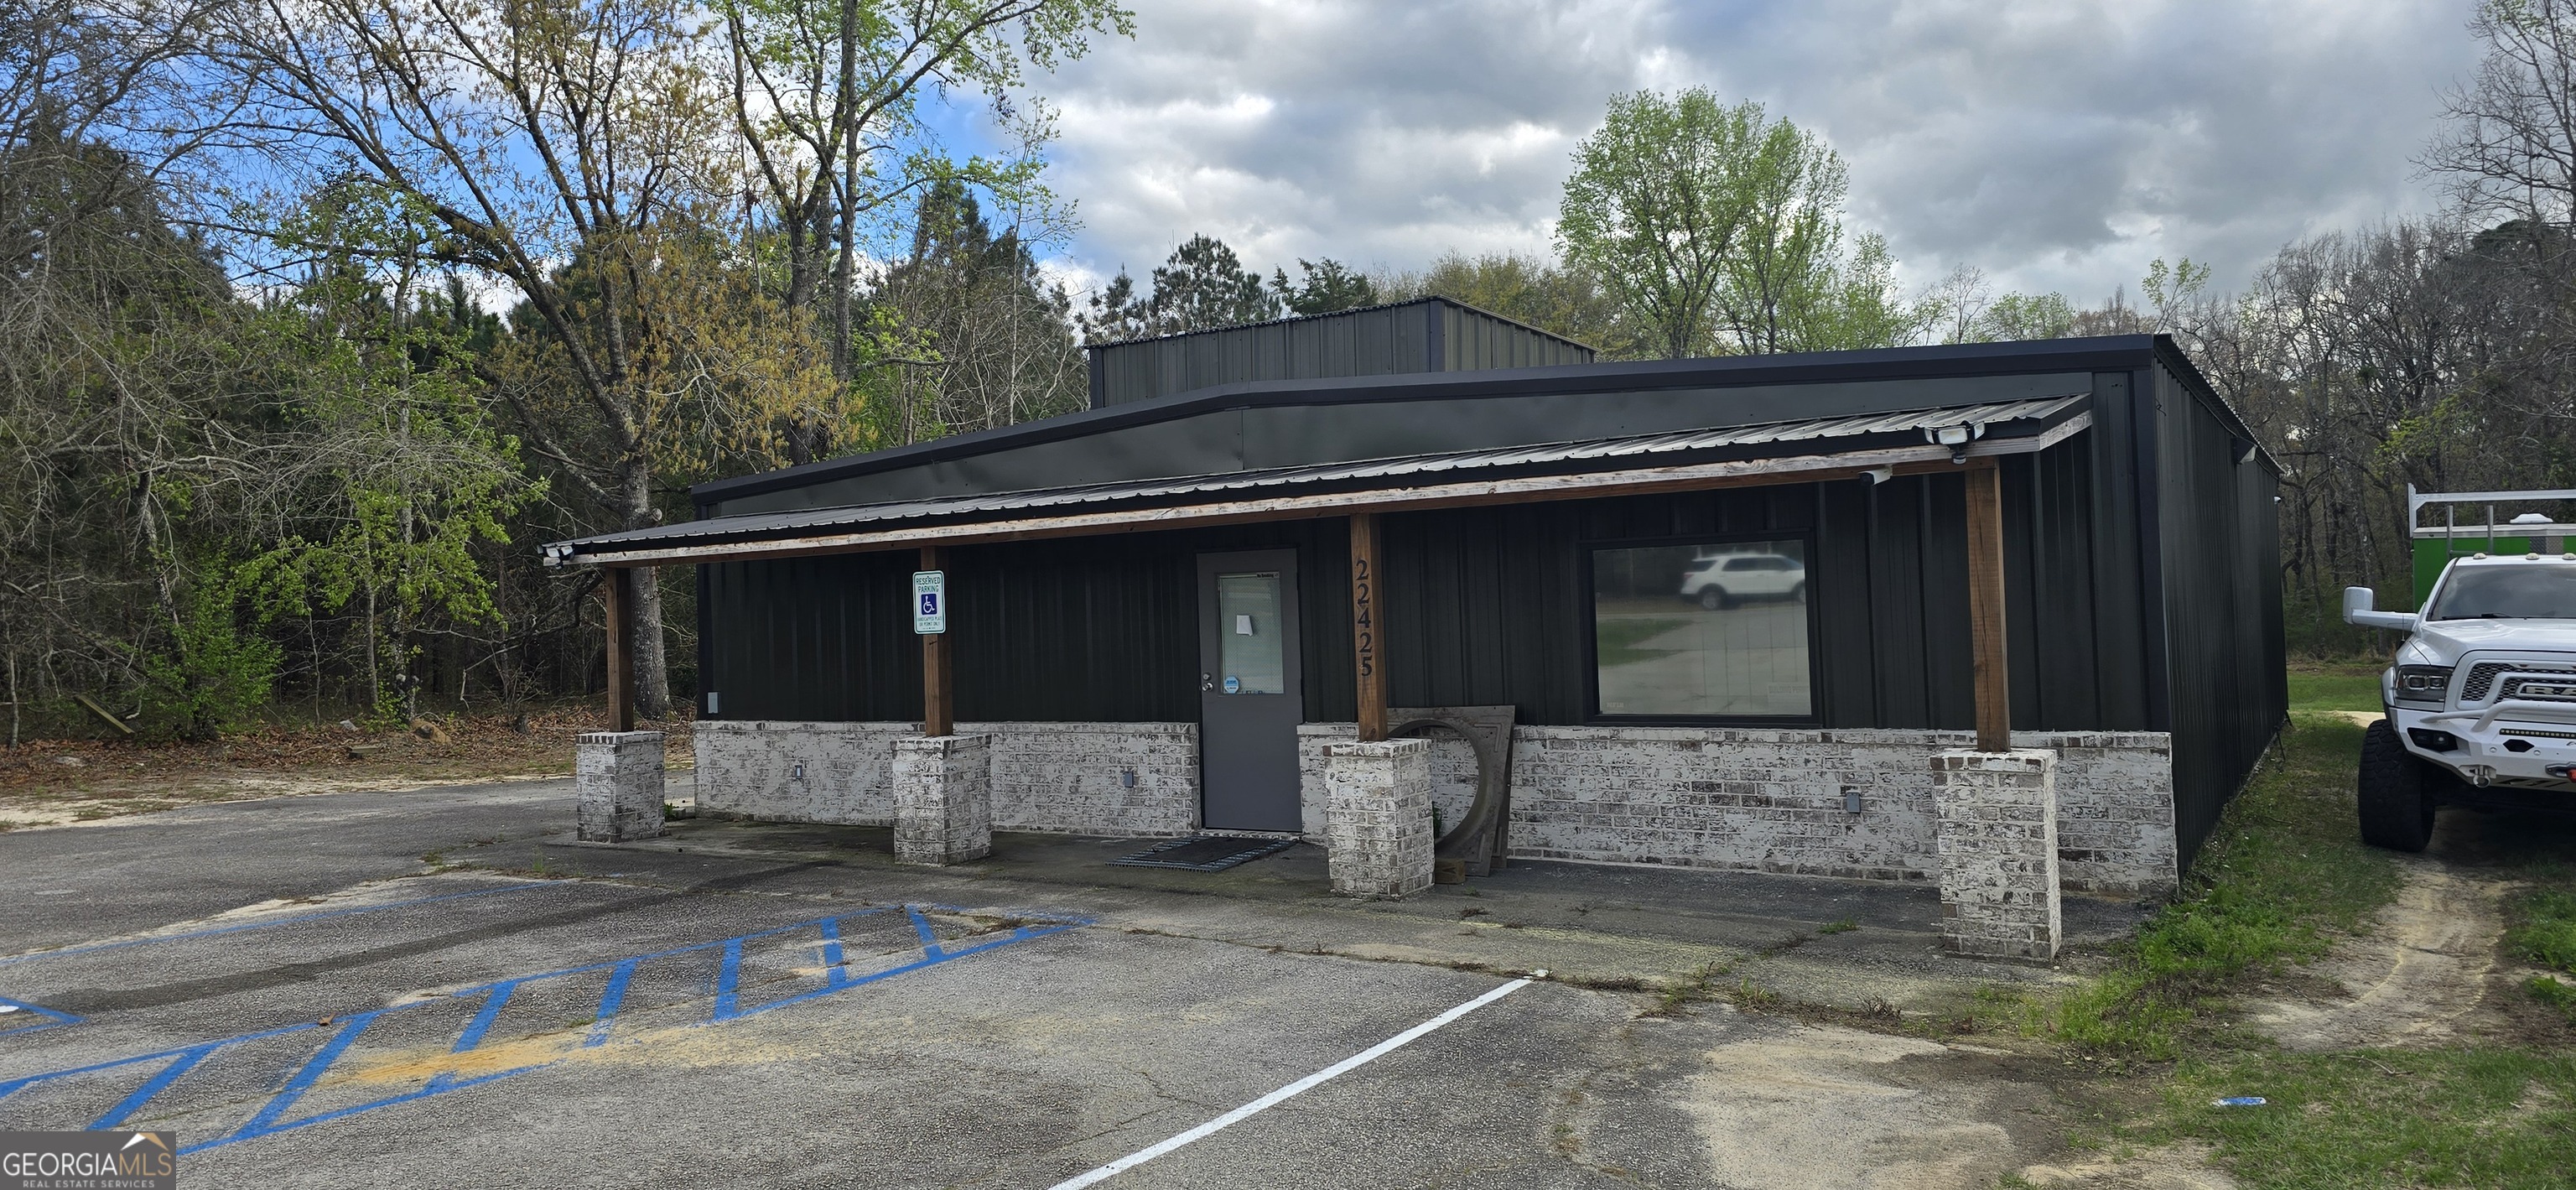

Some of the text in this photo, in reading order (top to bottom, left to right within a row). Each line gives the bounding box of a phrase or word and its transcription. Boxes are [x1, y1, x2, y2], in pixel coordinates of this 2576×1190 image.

[916, 576, 941, 585] RESERVED
[917, 585, 939, 593] PARKING
[1356, 559, 1373, 677] 22425
